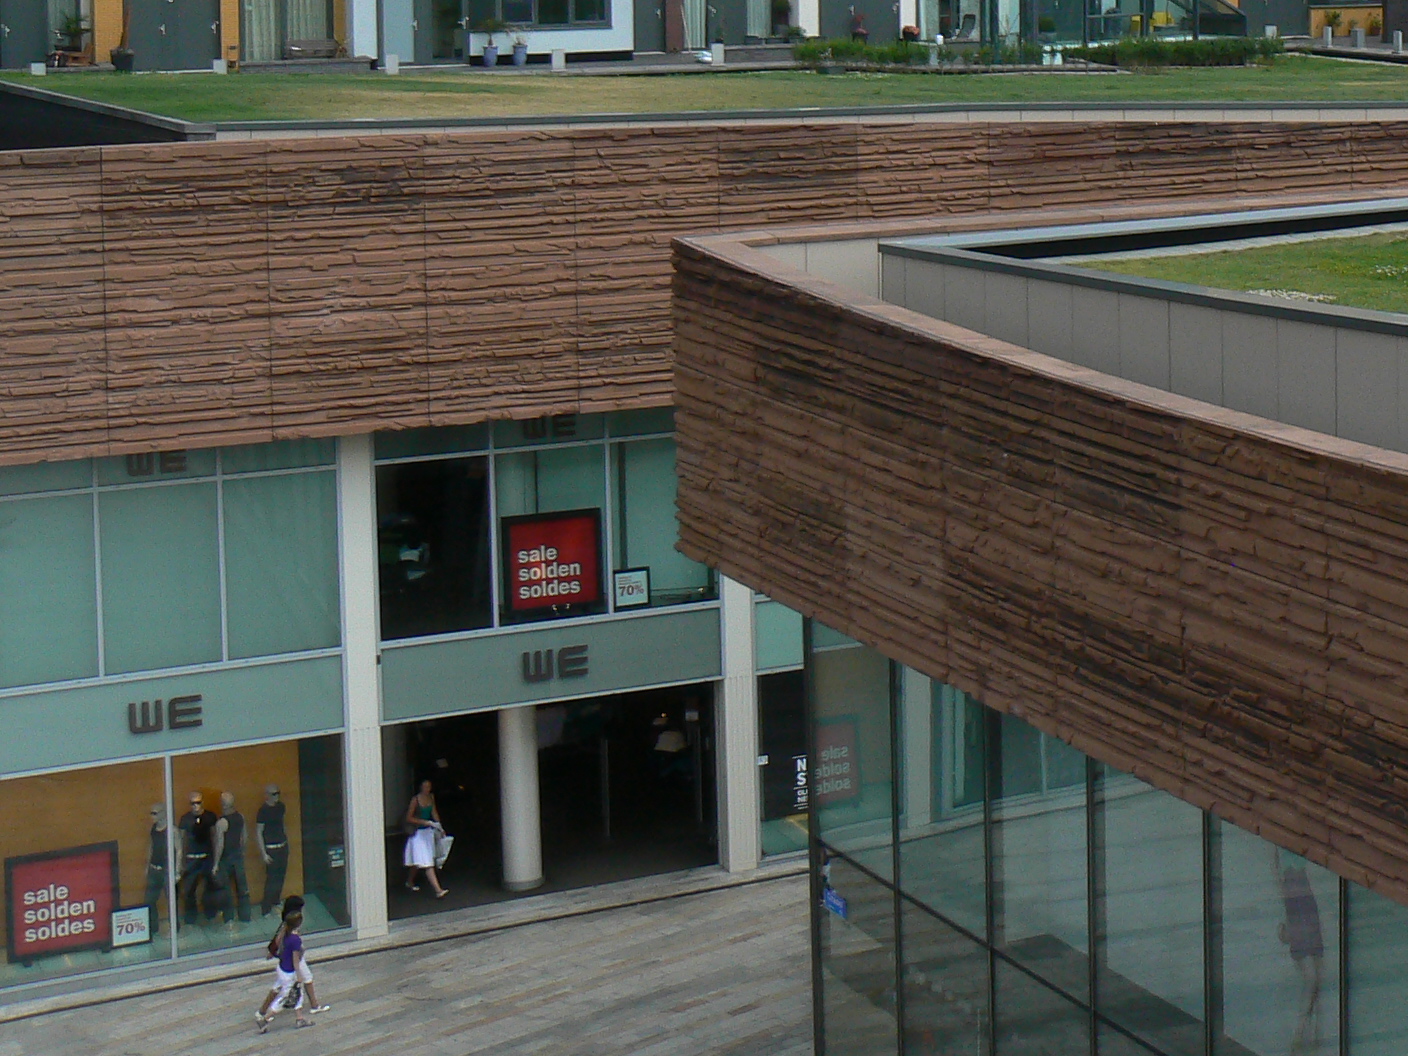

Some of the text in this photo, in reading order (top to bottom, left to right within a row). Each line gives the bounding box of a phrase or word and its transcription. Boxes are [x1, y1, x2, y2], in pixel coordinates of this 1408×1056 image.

[517, 545, 558, 563] sale
[518, 562, 581, 582] solden
[519, 579, 581, 599] soldes
[618, 584, 645, 597] 70%
[522, 644, 588, 684] WE
[128, 694, 203, 734] WE
[24, 883, 68, 905] sale
[24, 900, 95, 924] solden
[25, 918, 95, 942] soldes
[116, 921, 146, 936] 70%
